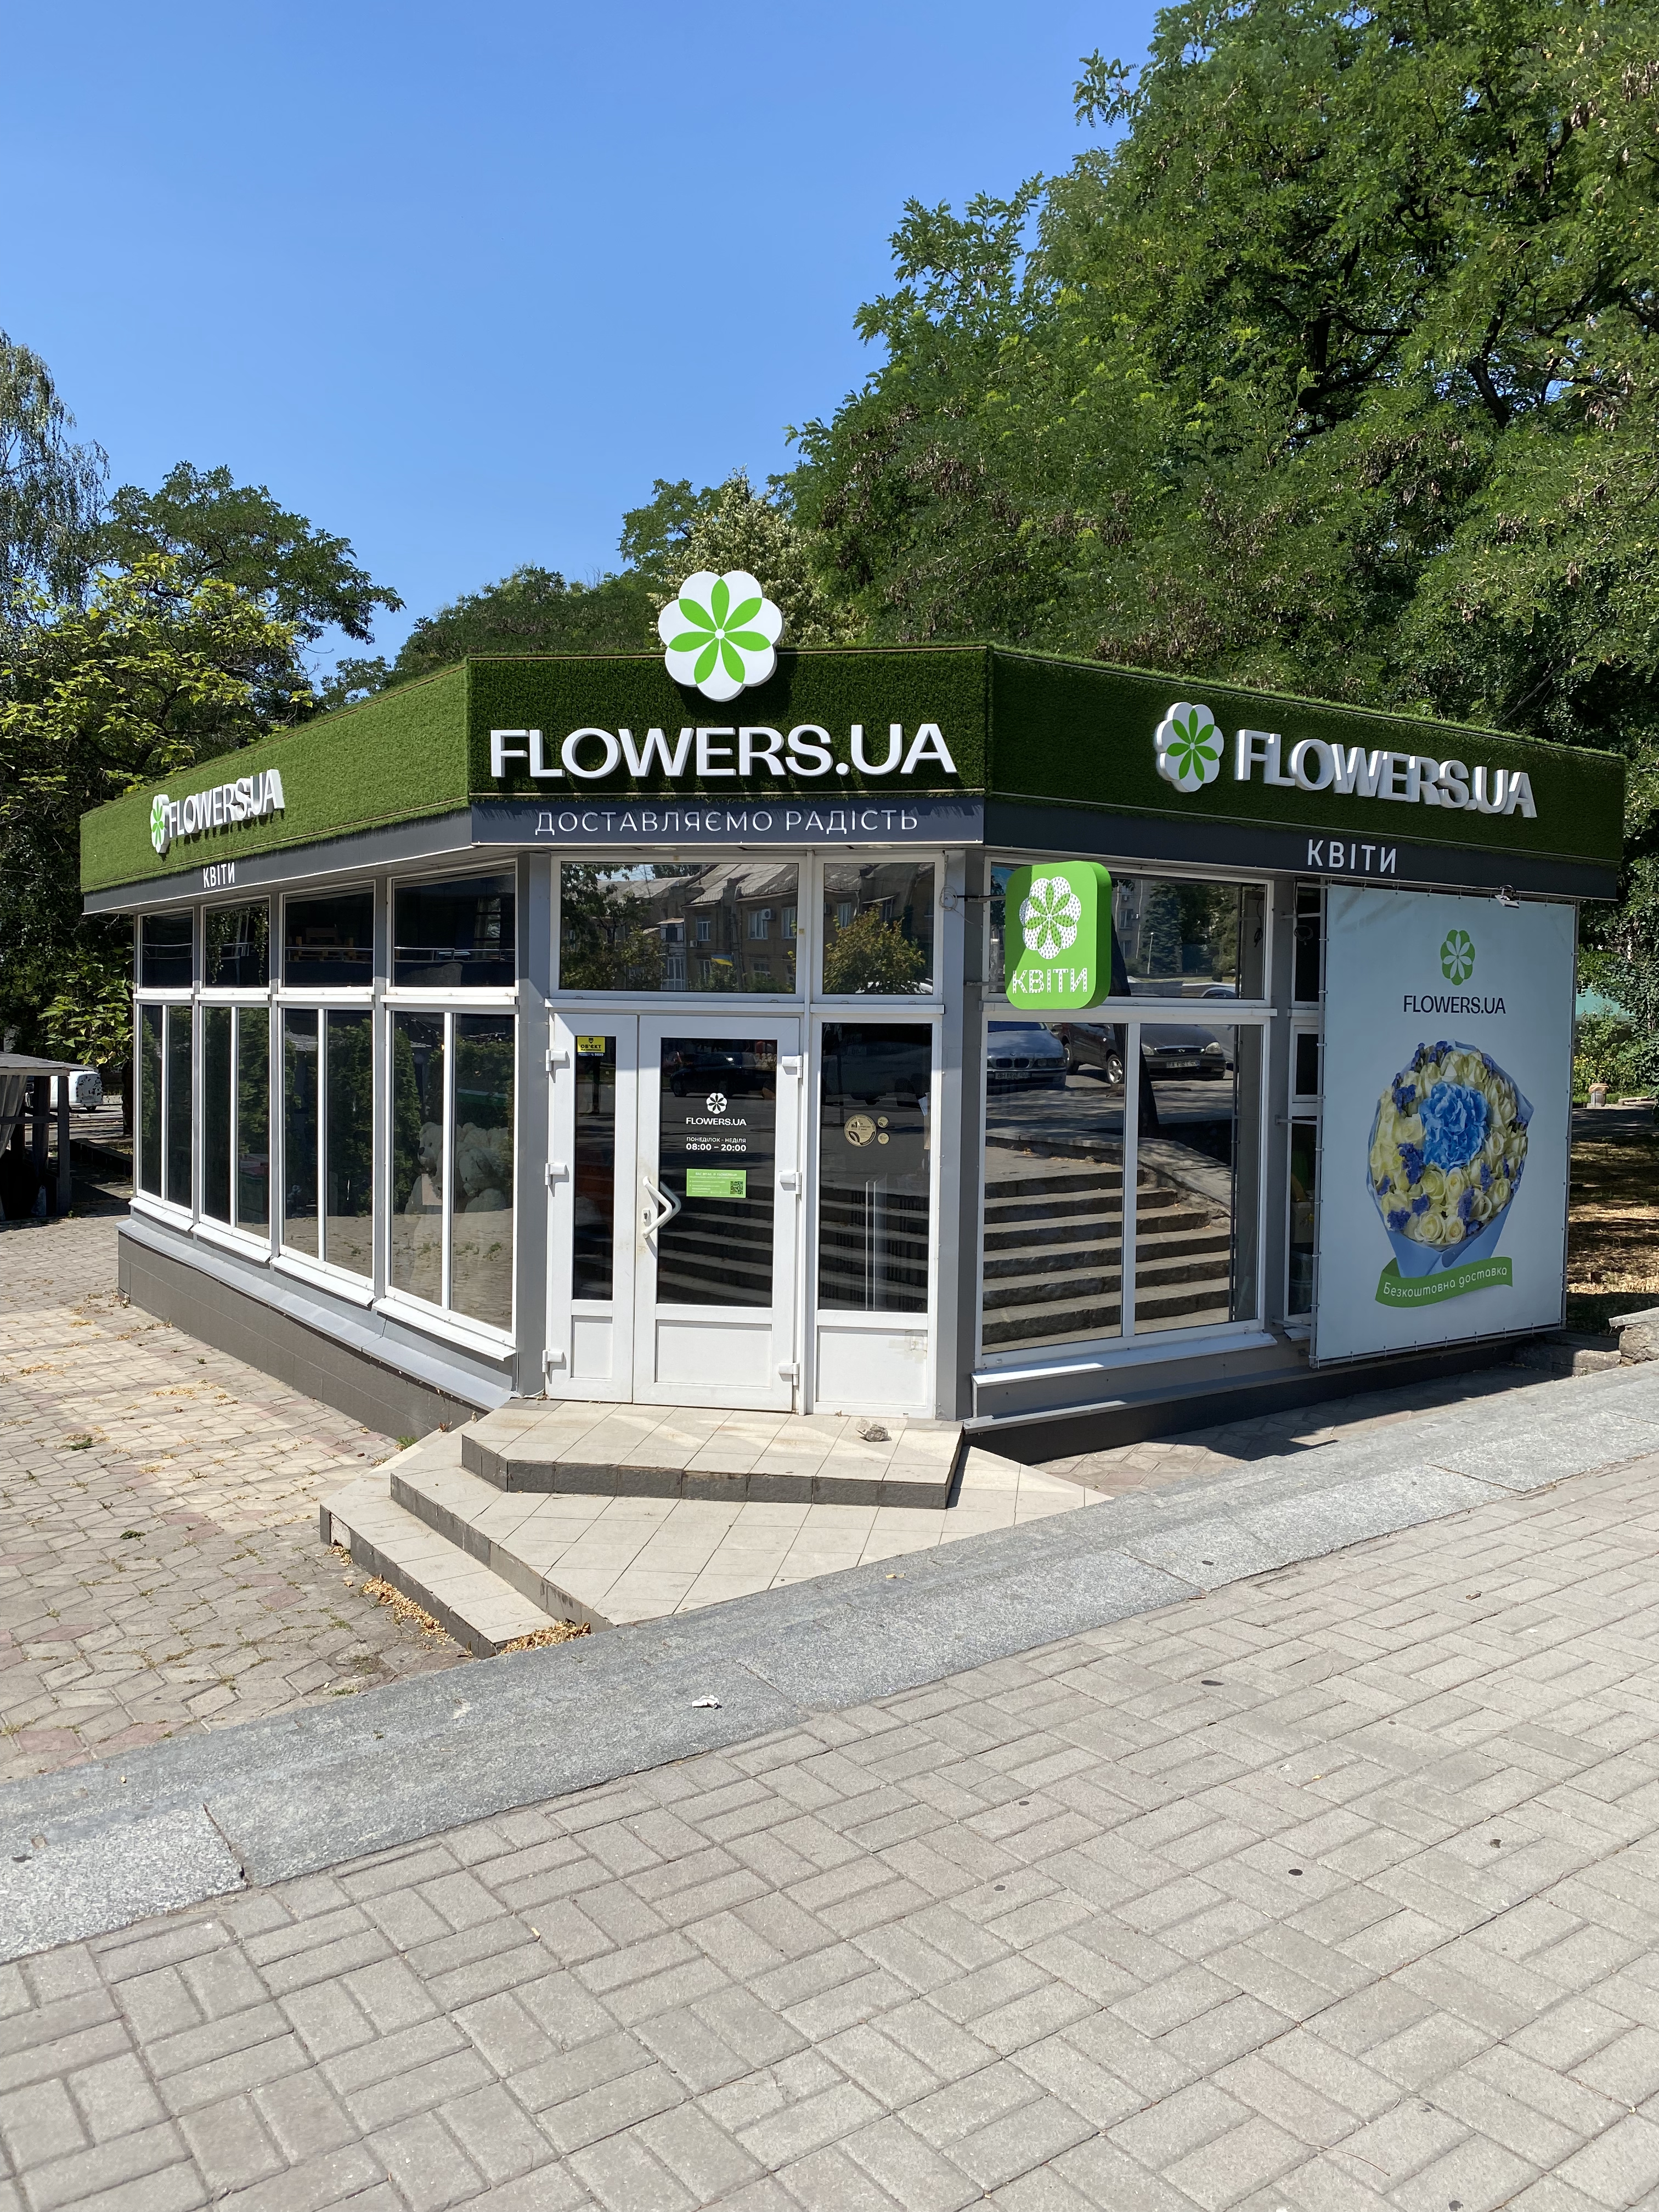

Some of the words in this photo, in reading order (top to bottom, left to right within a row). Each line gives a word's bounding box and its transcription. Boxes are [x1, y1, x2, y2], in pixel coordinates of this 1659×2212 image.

[490, 724, 957, 779] FLOWERS.UA
[1234, 729, 1537, 818] FLOWERS.UA
[535, 810, 772, 834] ДОСТАВЛЯЄМО
[786, 809, 918, 833] РАДІСТЬ
[1307, 839, 1397, 873] КВІТИ
[203, 862, 235, 888] КВІТИ
[1012, 968, 1087, 994] КВІТИ
[1403, 995, 1506, 1014] FLOWERS.UA
[686, 1117, 747, 1126] FLOWERS.UA
[686, 1143, 712, 1151] 08:00
[1383, 1279, 1456, 1298] Безкоштовна
[1459, 1267, 1508, 1288] доставка
